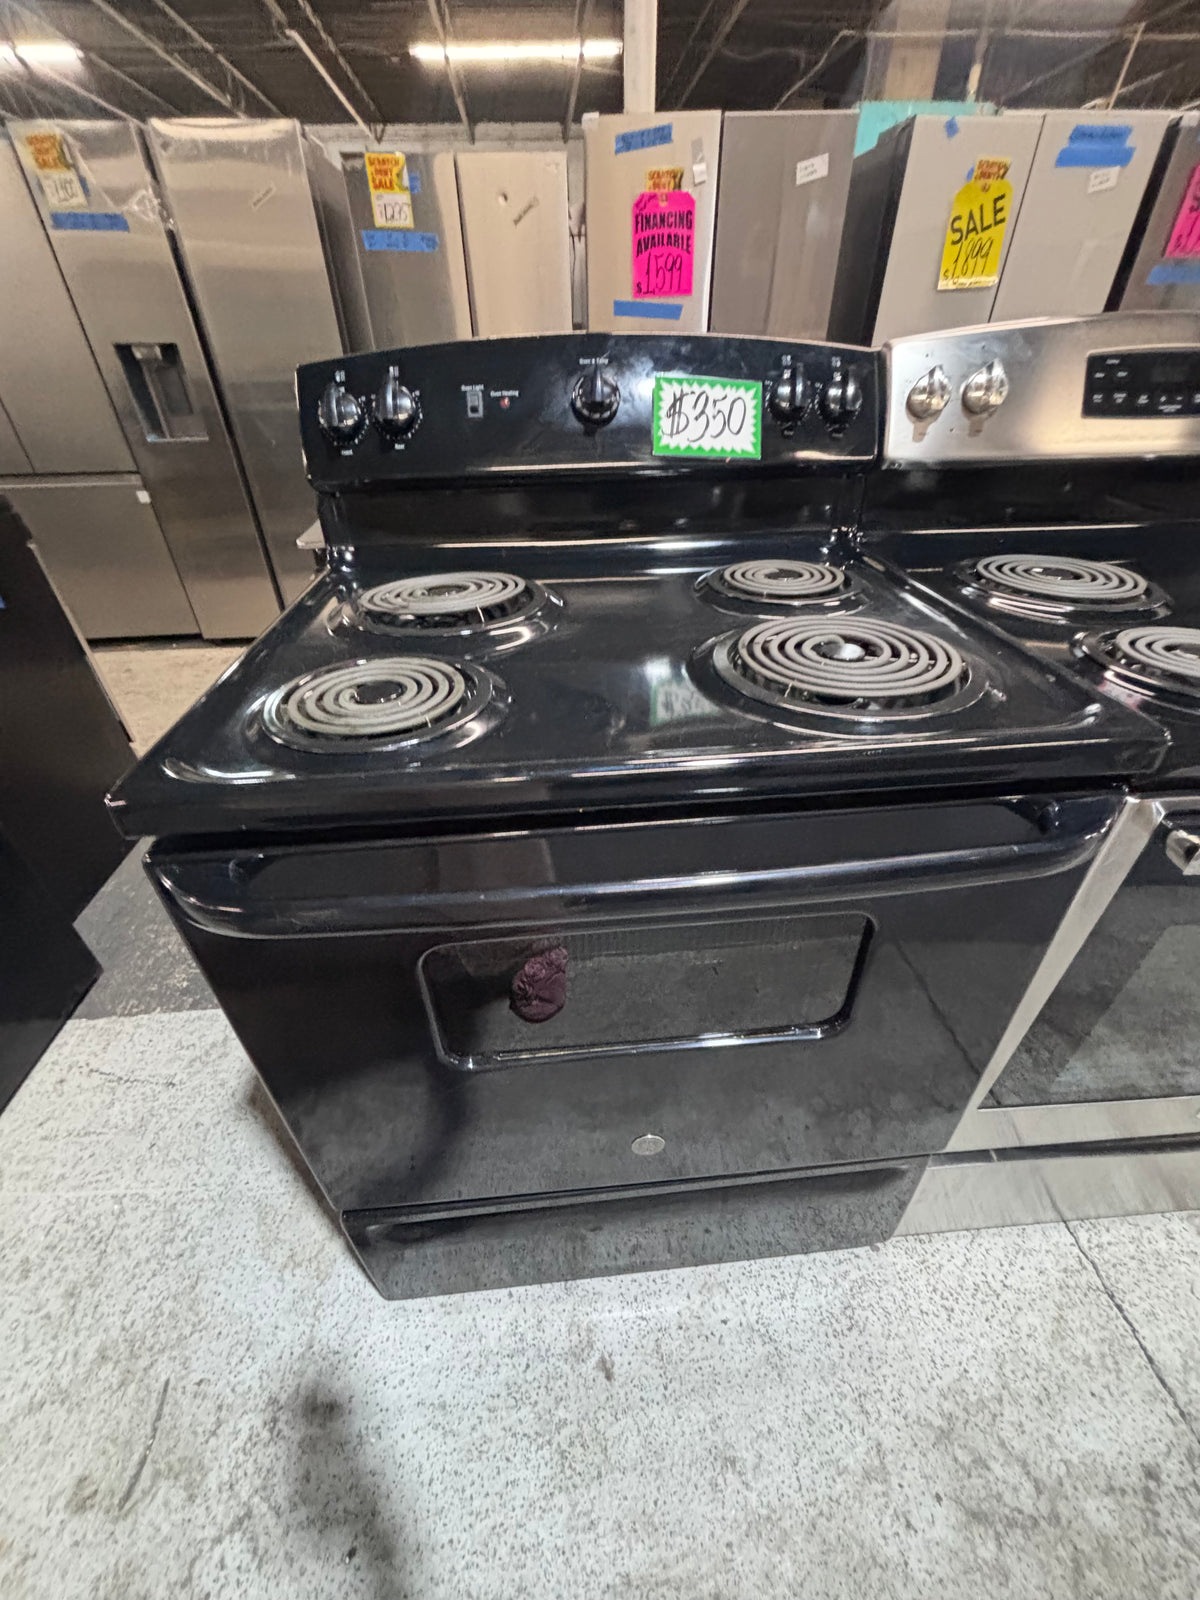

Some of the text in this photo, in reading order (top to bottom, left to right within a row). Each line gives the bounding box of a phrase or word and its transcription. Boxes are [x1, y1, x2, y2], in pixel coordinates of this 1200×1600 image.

[635, 209, 693, 234] FINANCING
[950, 193, 1007, 246] SALE
[636, 233, 692, 257] AVAILABLE
[661, 387, 747, 443] $350
